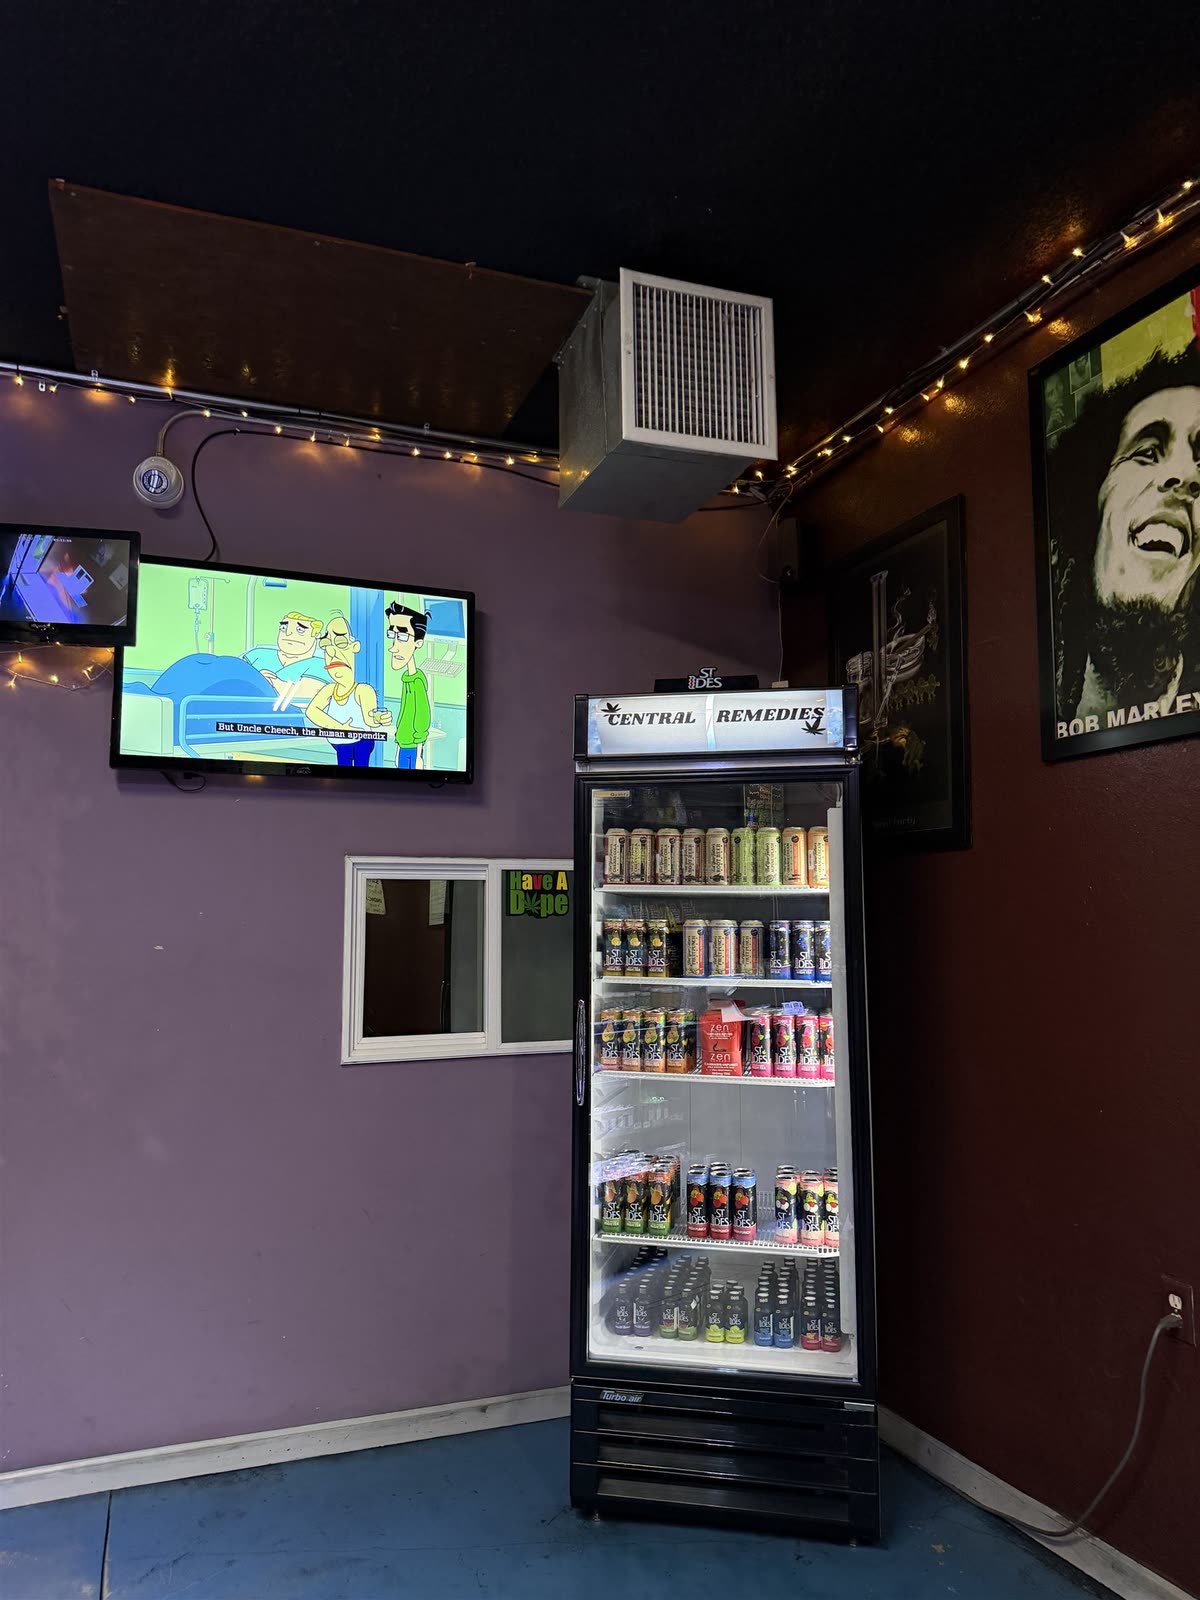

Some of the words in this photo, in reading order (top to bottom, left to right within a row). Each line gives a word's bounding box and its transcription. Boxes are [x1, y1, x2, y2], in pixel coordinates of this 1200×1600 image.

[699, 667, 716, 679] ST
[606, 710, 696, 727] CENTRAL
[715, 706, 825, 724] REMEDIES
[218, 722, 234, 732] But
[237, 724, 262, 734] Uncle
[264, 725, 299, 737] Cheech,
[302, 728, 316, 737] the
[318, 729, 346, 739] human
[347, 731, 387, 742] appendix
[1056, 714, 1100, 739] BOB
[509, 870, 553, 891] Have
[556, 871, 569, 891] A
[825, 952, 831, 961] S
[710, 1023, 729, 1033] zen
[710, 1052, 731, 1061] zen
[607, 1201, 617, 1212] ST
[630, 1203, 639, 1214] ST
[654, 1204, 664, 1215] ST
[693, 1207, 702, 1217] ST
[716, 1208, 725, 1219] ST
[737, 1210, 747, 1220] ST
[602, 1389, 627, 1402] Turbo
